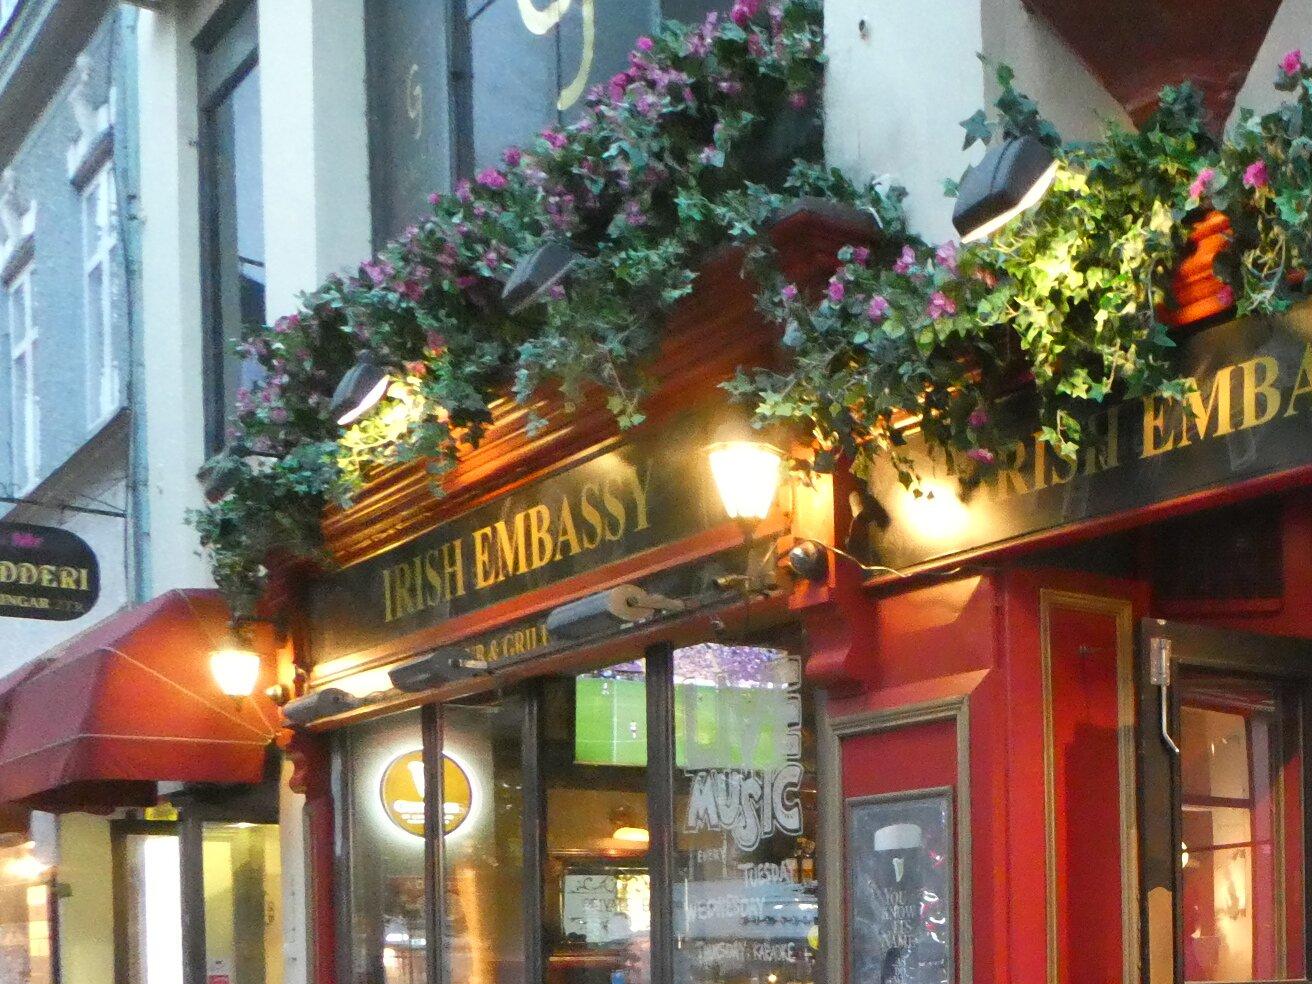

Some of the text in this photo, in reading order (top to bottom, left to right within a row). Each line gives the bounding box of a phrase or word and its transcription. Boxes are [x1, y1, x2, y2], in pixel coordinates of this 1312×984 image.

[382, 466, 650, 623] IRISH EMBASSY
[683, 762, 804, 852] MUSIC
